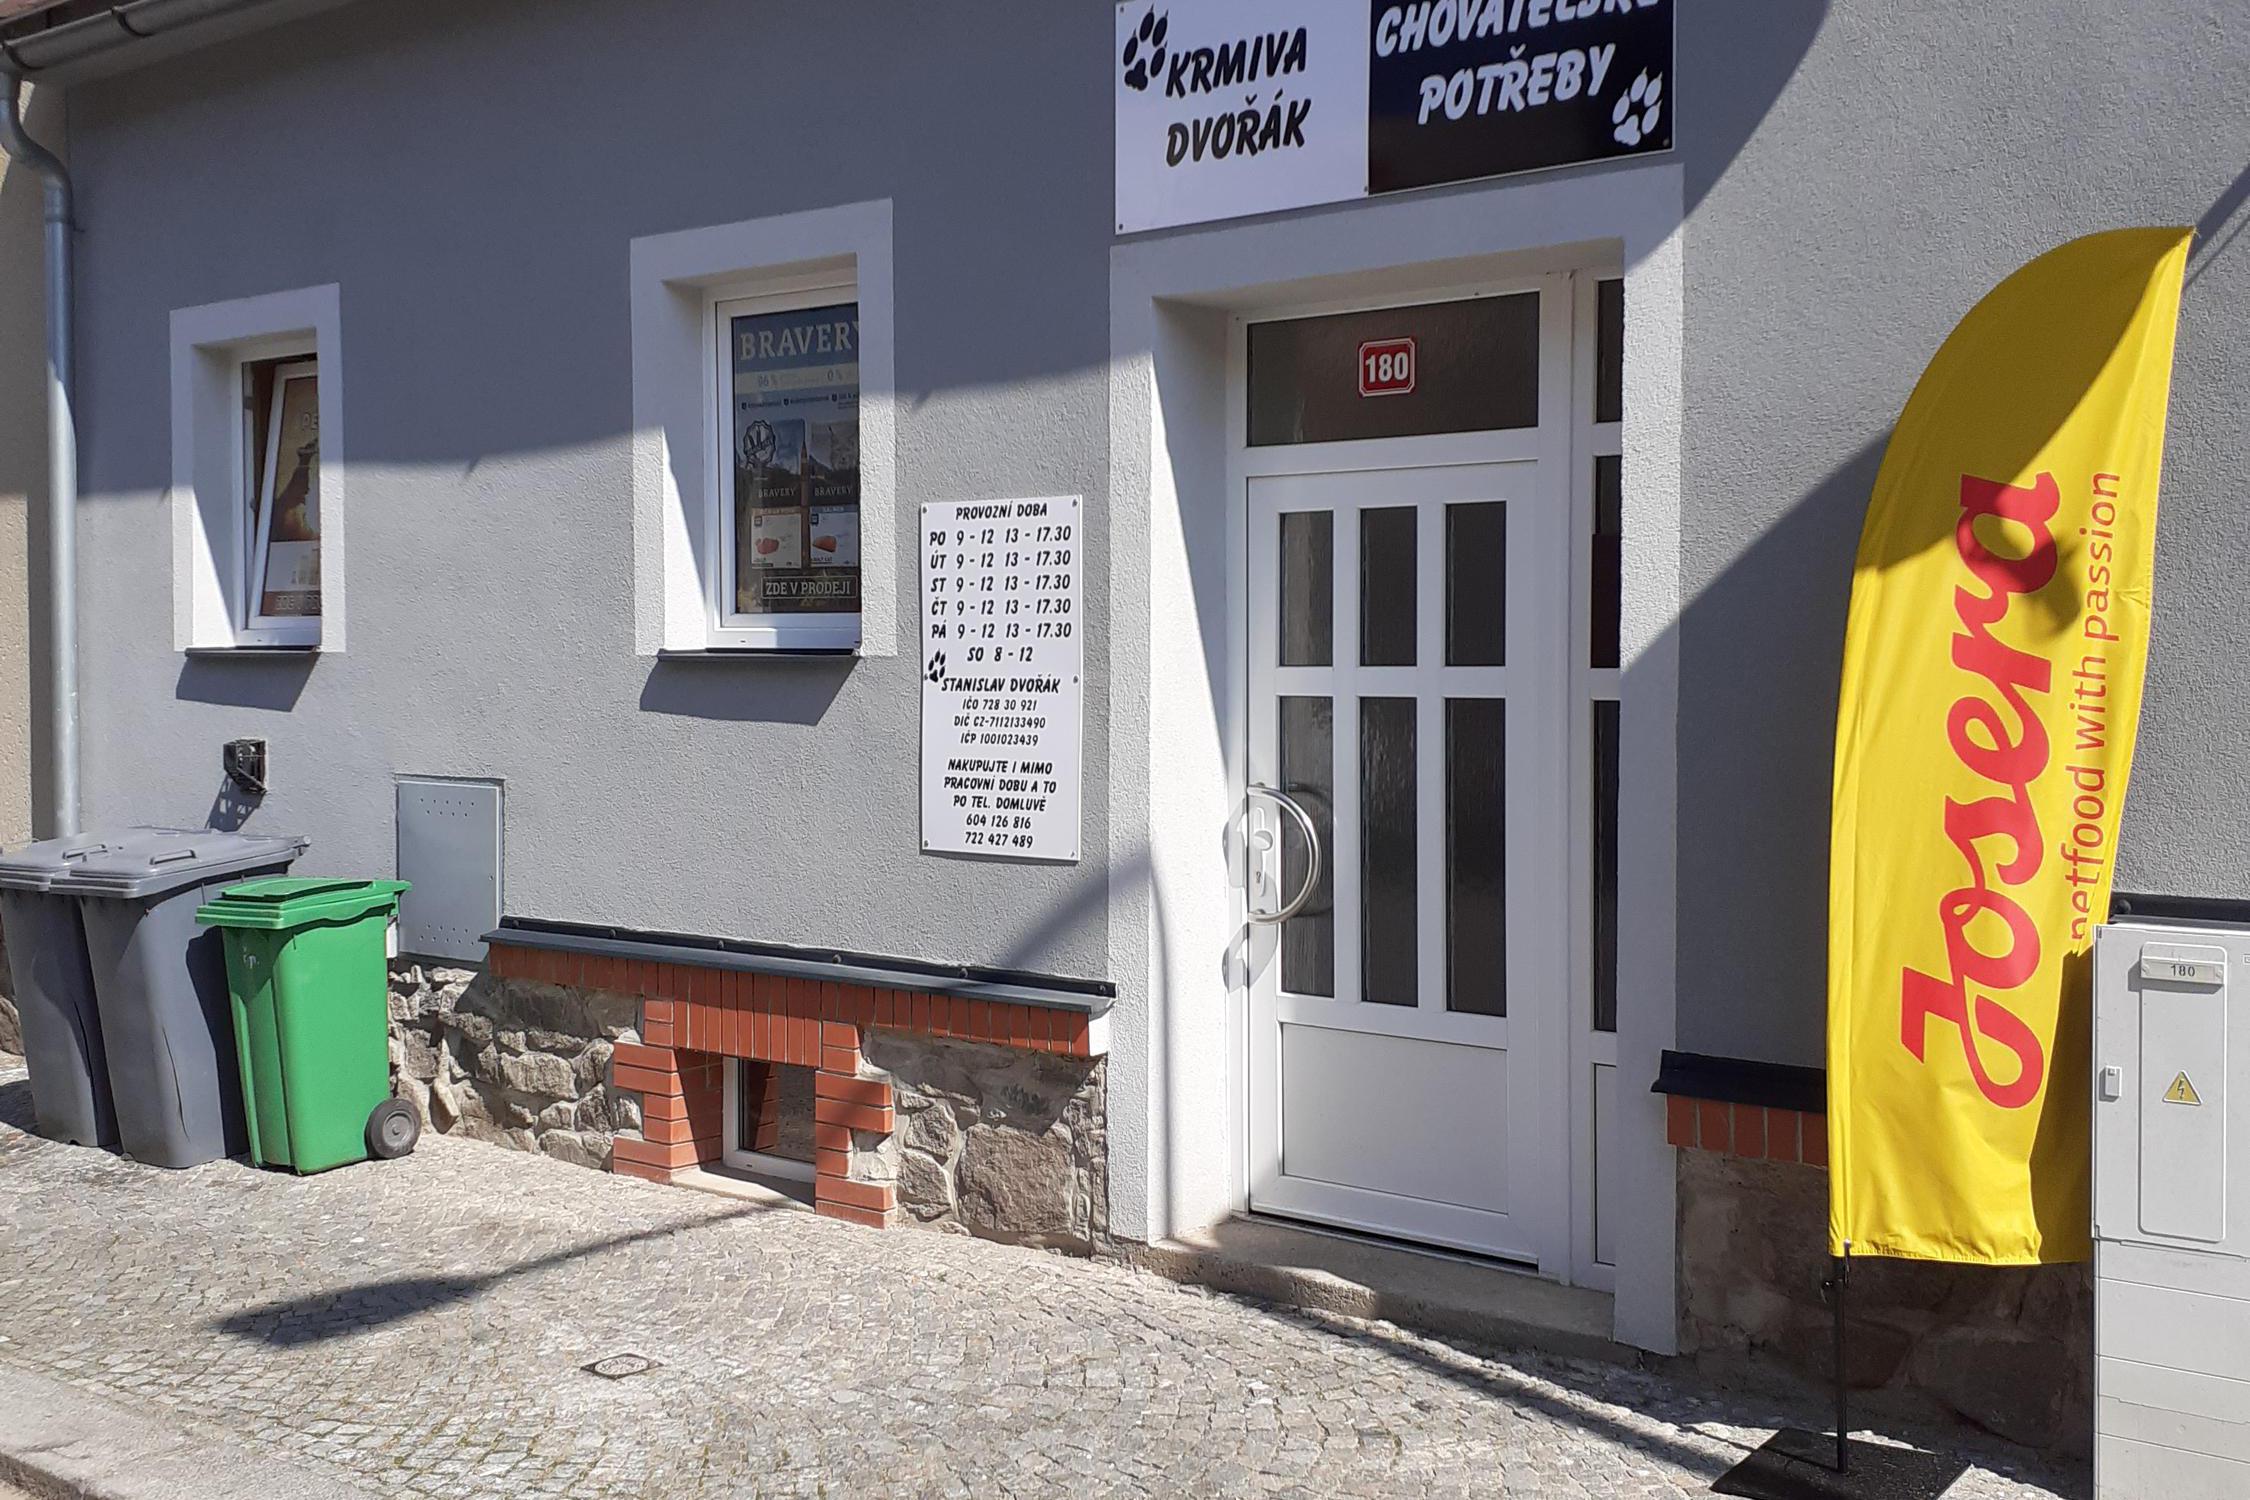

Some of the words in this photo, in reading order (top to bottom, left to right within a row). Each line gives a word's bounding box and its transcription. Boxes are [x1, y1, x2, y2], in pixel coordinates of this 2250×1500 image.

[1166, 28, 1307, 97] KRMIVA
[1418, 43, 1616, 124] POTŘEBY
[1166, 90, 1311, 167] DVOŘÁK
[740, 320, 859, 360] BRAVER
[1365, 352, 1409, 384] 180
[955, 501, 1013, 520] PROVOZNÍ
[1017, 503, 1047, 517] DOBA
[929, 531, 946, 546] PO
[956, 530, 964, 546] 9
[981, 529, 994, 544] 12
[1005, 528, 1019, 543] 13
[1036, 526, 1071, 542] 17.30
[930, 550, 947, 569] ÚT
[956, 554, 964, 569] 9
[981, 553, 994, 568] 12
[1005, 552, 1018, 567] 13
[1036, 550, 1071, 566] 17.30
[2078, 472, 2121, 641] passion
[766, 582, 788, 595] ZDE
[790, 582, 800, 594] V
[802, 581, 851, 595] PRODEJI
[930, 578, 947, 592] ST
[956, 577, 964, 592] 9
[980, 576, 993, 592] 12
[1005, 576, 1018, 591] 13
[1036, 574, 1070, 590] 17.30
[931, 597, 947, 616] ČT
[957, 601, 964, 616] 9
[981, 600, 994, 615] 12
[1005, 600, 1019, 614] 13
[1036, 599, 1071, 614] 17.30
[931, 620, 947, 639] PÁ
[957, 624, 965, 639] 9
[982, 623, 995, 638] 12
[1006, 623, 1019, 638] 13
[1037, 622, 1071, 638] 17.30
[967, 647, 984, 661] SO
[994, 647, 1002, 661] 8
[1020, 647, 1033, 662] 12
[941, 678, 1005, 692] STANISLAV
[1010, 674, 1061, 693] DVOŘÁK
[963, 696, 979, 710] IČO
[983, 699, 1000, 710] 728
[1004, 700, 1016, 710] 30
[1021, 700, 1037, 711] 921
[2068, 654, 2108, 752] with
[954, 713, 970, 726] DIČ
[974, 716, 1045, 728] CZ-7112133490
[960, 730, 976, 744] IČP
[980, 734, 1038, 746] 1001023439
[948, 759, 1008, 773] NAKUPUJTE
[1012, 761, 1016, 773] I
[1020, 762, 1052, 774] MIMO
[944, 775, 995, 791] PRACOVNÍ
[999, 779, 1027, 792] DOBU
[1031, 781, 1038, 792] A
[1043, 781, 1057, 793] TO
[1900, 471, 2061, 1109] Josera
[953, 795, 967, 807] PO
[972, 796, 991, 809] TEL.
[996, 796, 1046, 811] DOMLUVĚ
[966, 814, 986, 826] 604
[991, 815, 1008, 827] 126
[1013, 816, 1031, 829] 816
[965, 832, 984, 845] 722
[988, 833, 1008, 845] 427
[1012, 835, 1033, 848] 489
[2171, 964, 2195, 977] 180
